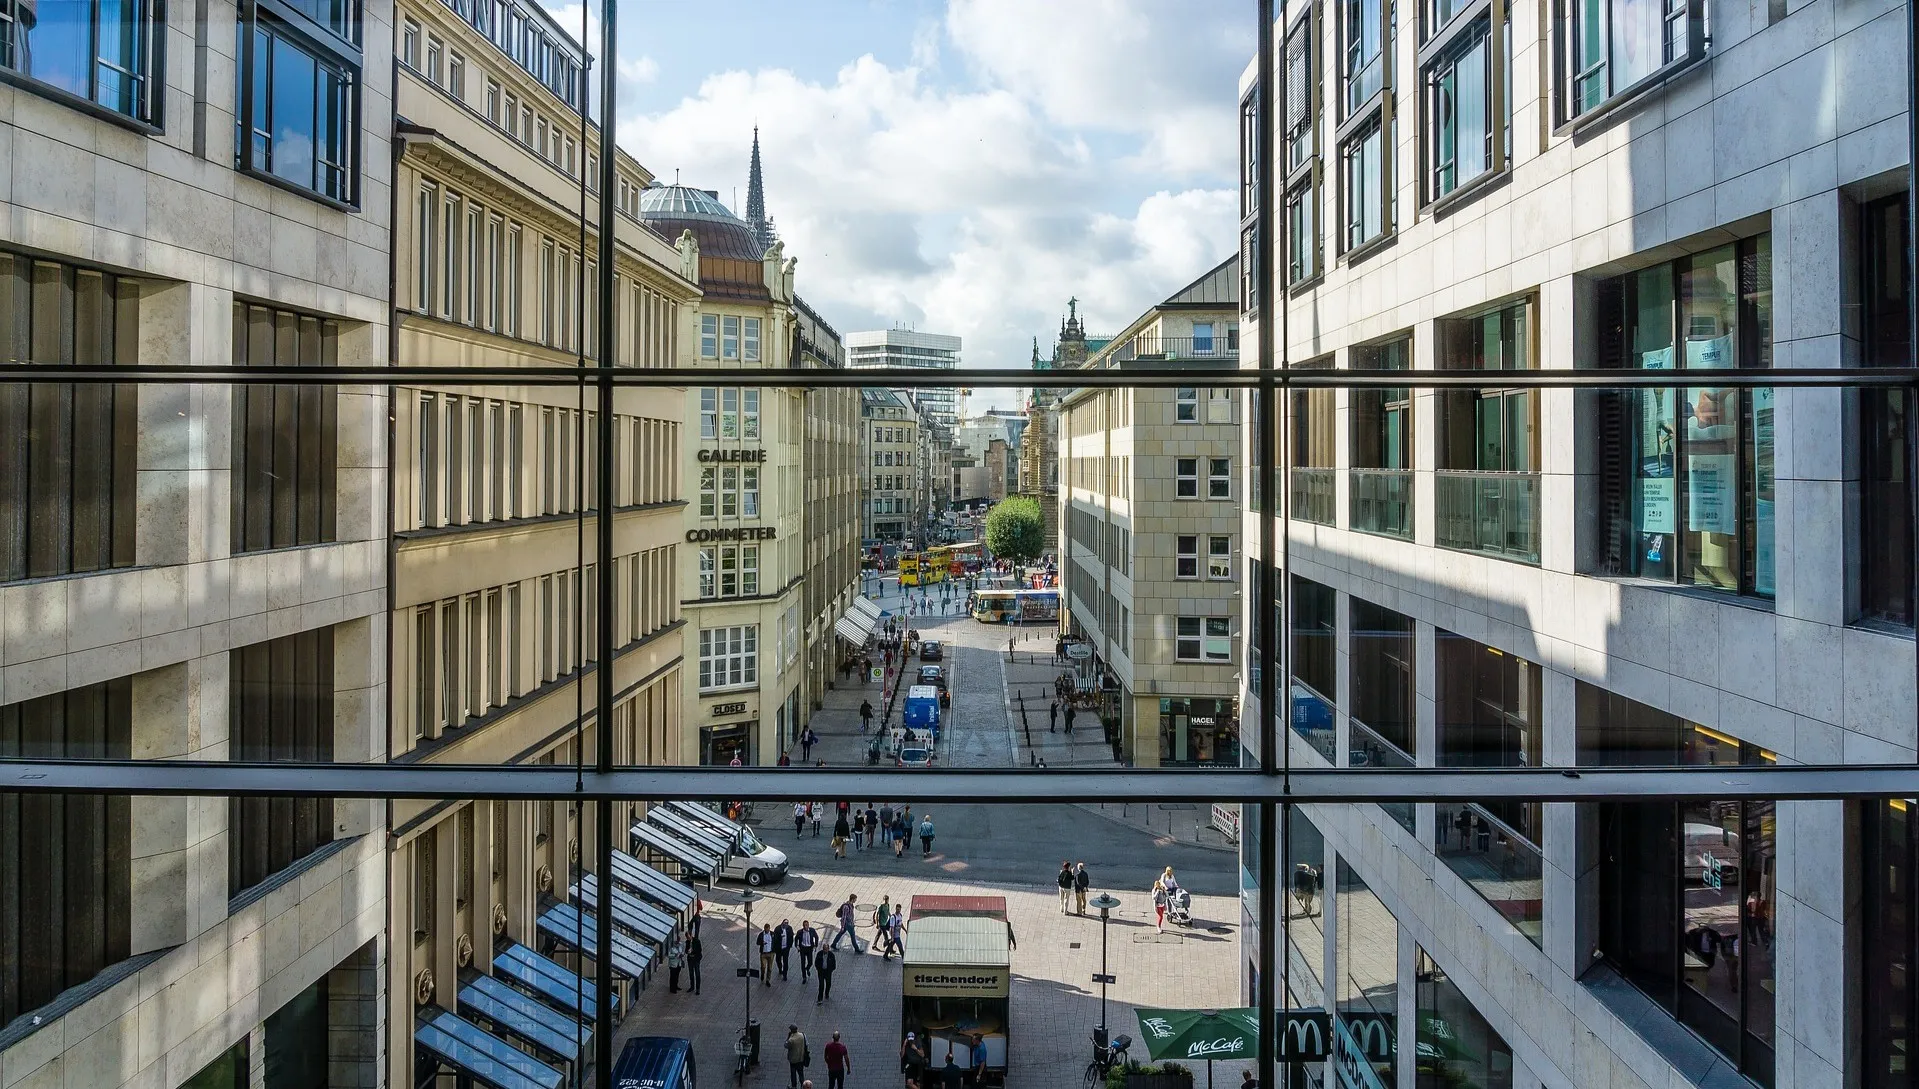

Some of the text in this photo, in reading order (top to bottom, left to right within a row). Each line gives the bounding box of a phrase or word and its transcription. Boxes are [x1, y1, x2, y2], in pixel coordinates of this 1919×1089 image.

[1701, 350, 1721, 360] TEMPUR
[697, 449, 767, 463] GALERIE
[686, 527, 777, 543] COMMETER
[714, 703, 746, 714] CLOSED
[1702, 850, 1721, 872] cha
[914, 975, 998, 984] tischendorf
[1187, 1036, 1244, 1057] McCafé
